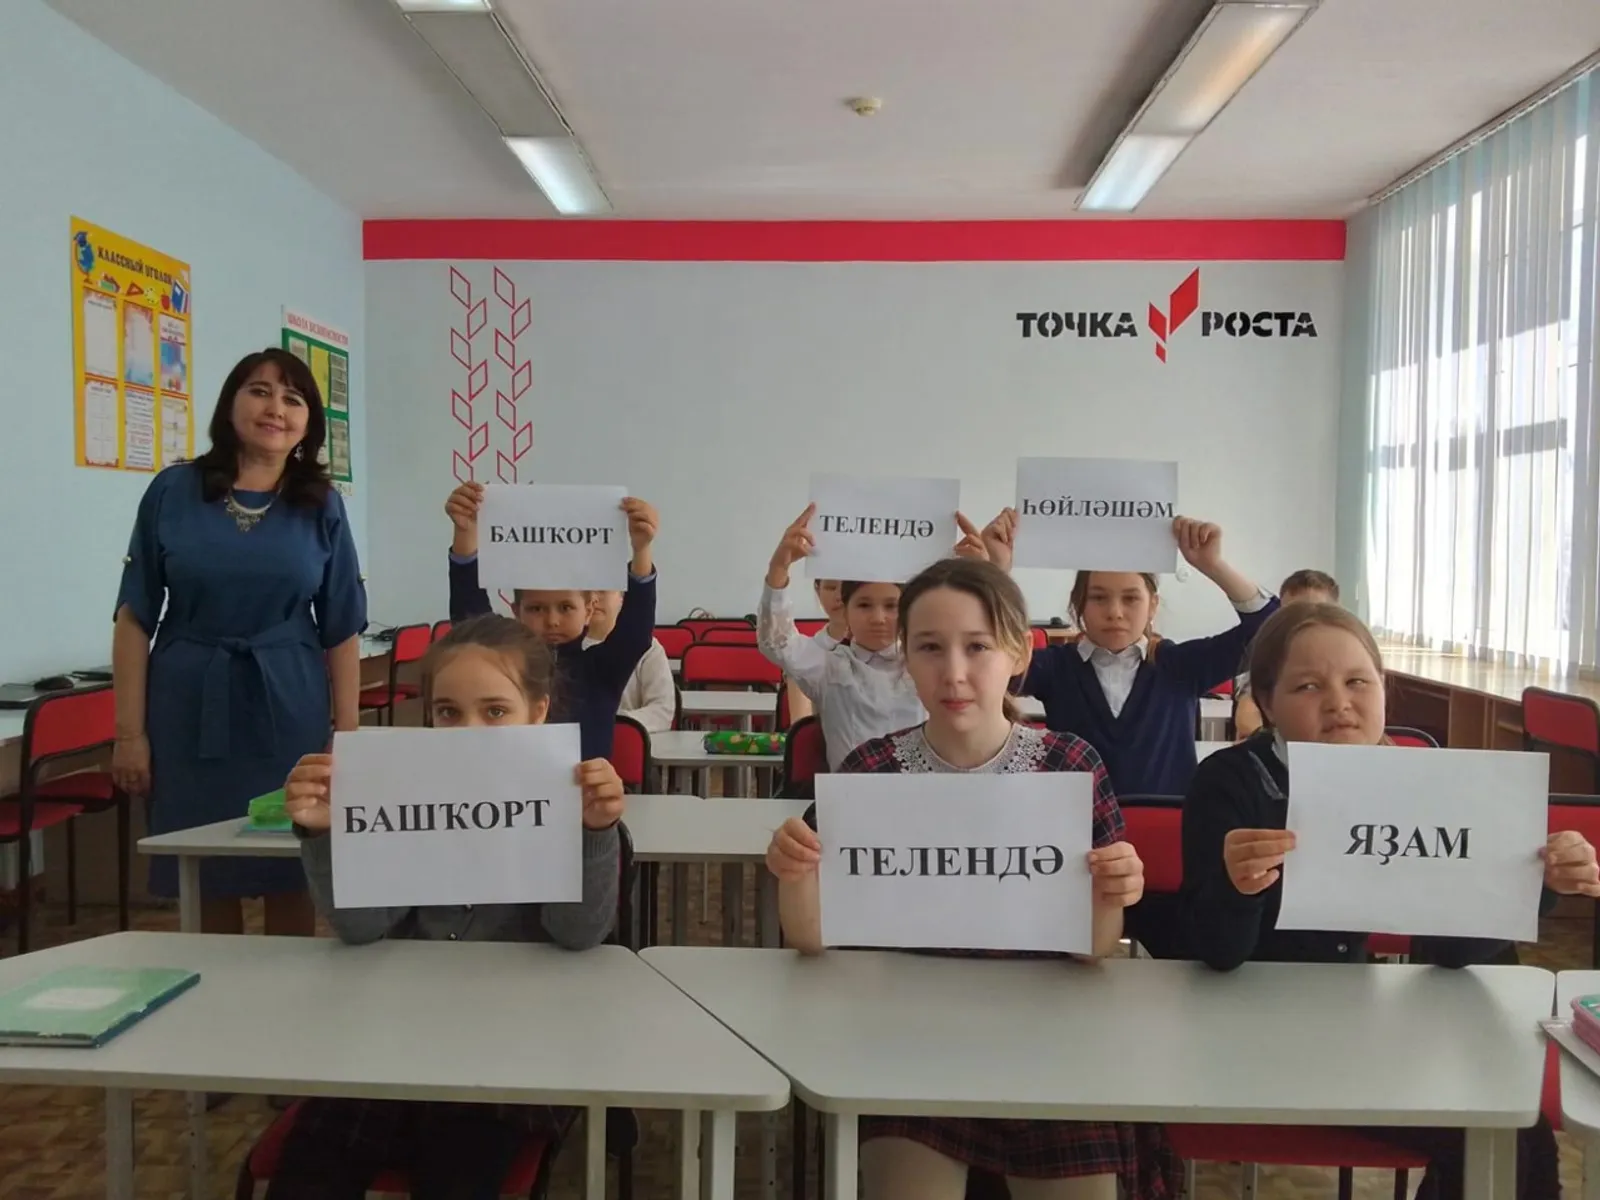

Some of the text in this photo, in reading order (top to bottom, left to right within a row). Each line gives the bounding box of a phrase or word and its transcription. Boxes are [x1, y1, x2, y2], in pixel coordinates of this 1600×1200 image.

[97, 245, 172, 285] КЛАССНЫЙ УГОЛОК
[1016, 311, 1318, 337] ТОЧКА РОСТА
[490, 525, 613, 544] БАШҠОРТ
[819, 514, 934, 540] ТЕЛЕНДӘ
[343, 799, 550, 834] БАШҠОРТ
[1343, 823, 1472, 866] ЯҘАМ
[839, 844, 1064, 883] ТЕЛЕНДӘ
